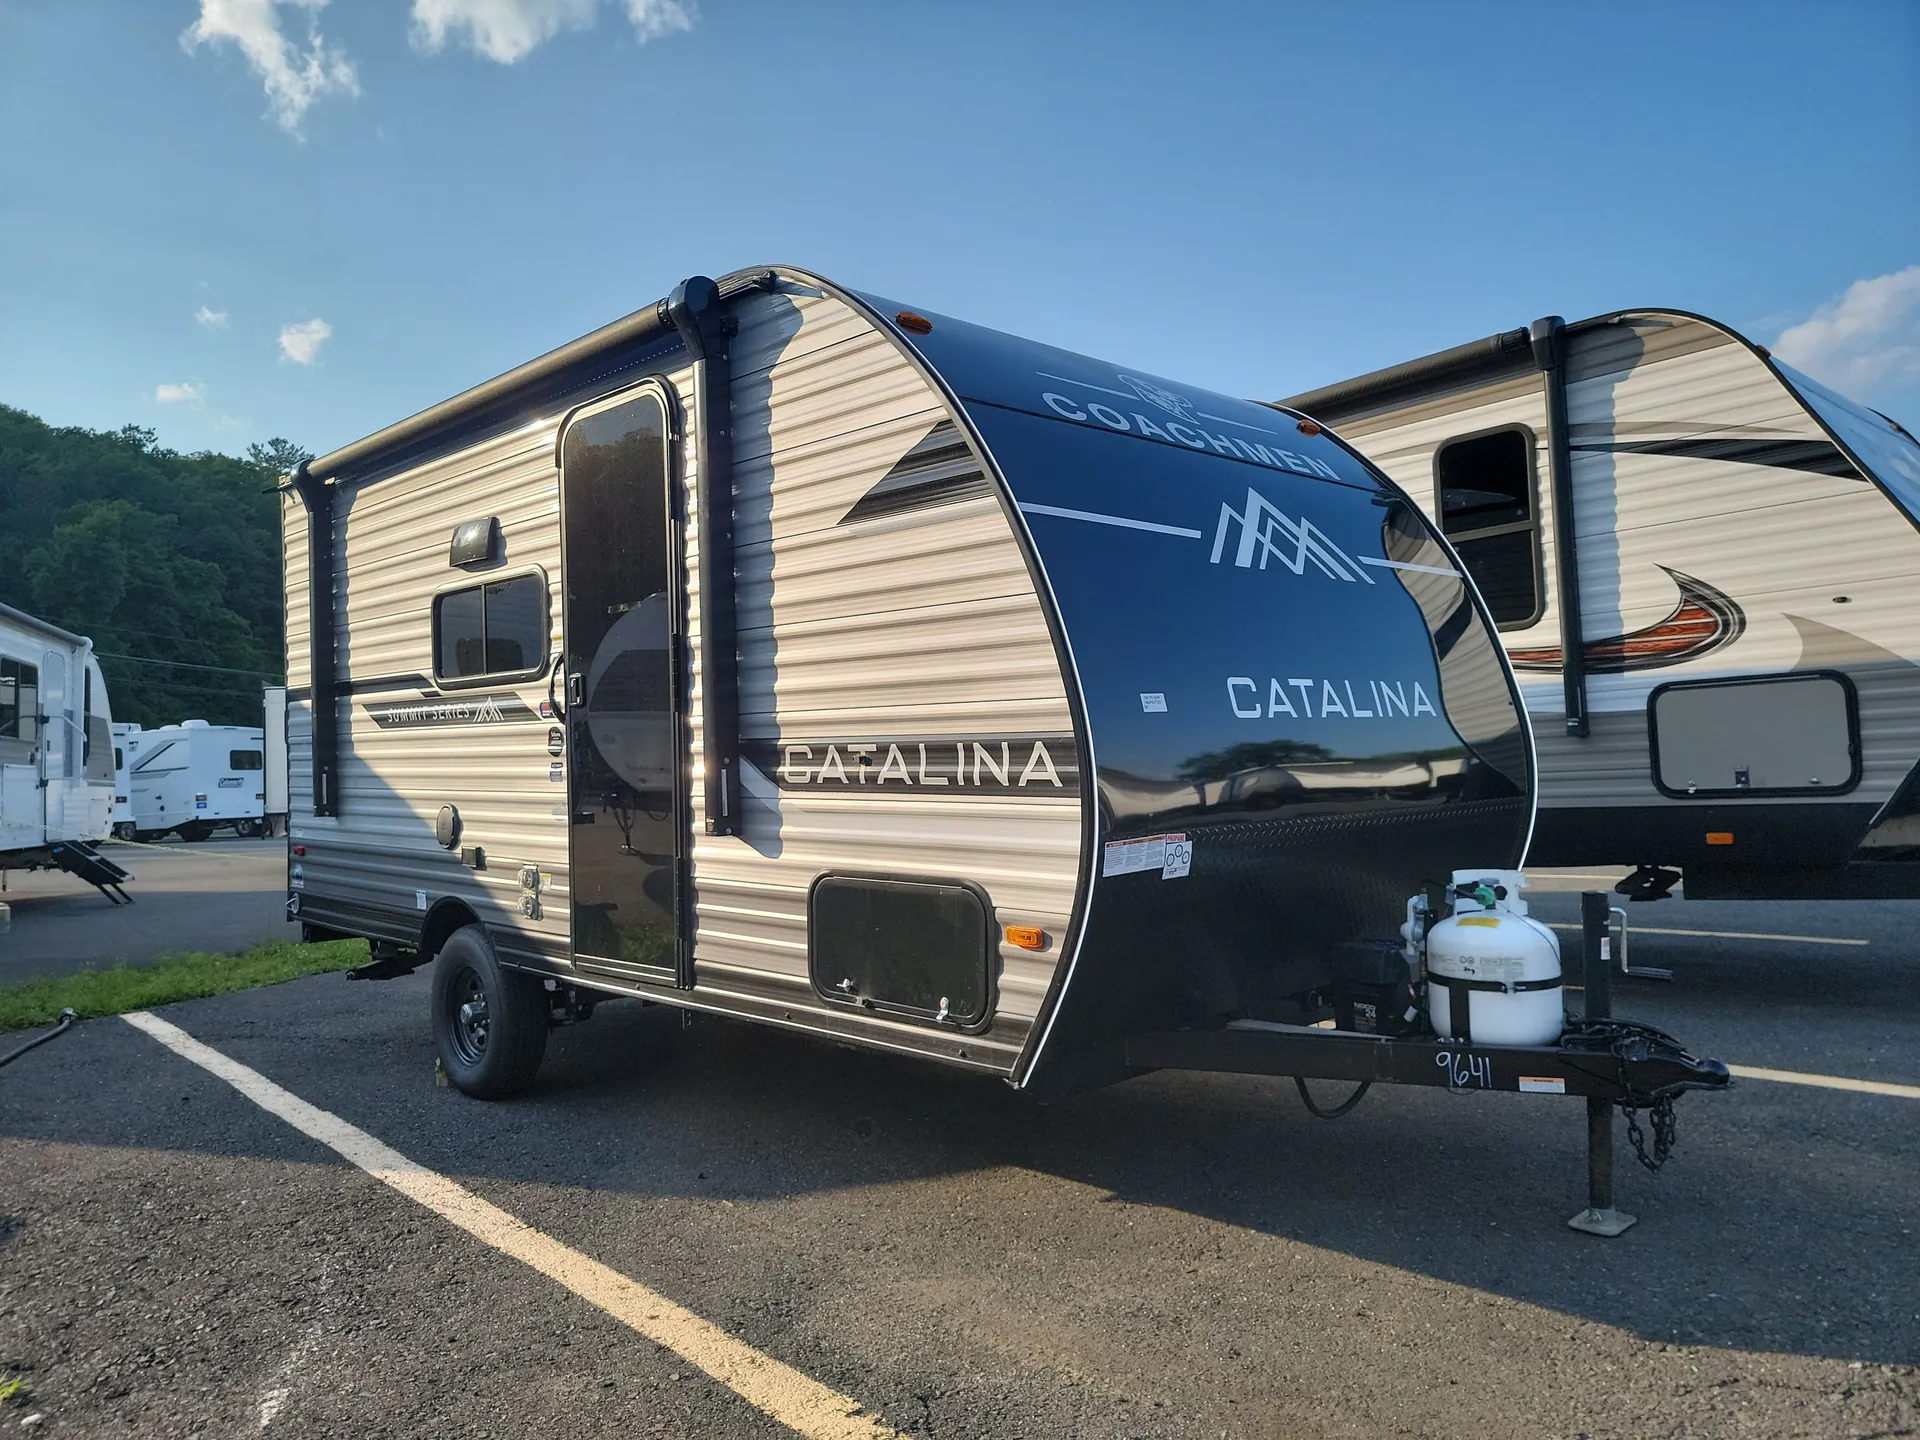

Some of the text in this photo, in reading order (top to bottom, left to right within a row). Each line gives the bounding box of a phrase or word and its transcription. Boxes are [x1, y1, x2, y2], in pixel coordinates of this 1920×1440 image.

[1042, 392, 1341, 481] COACHMEN
[388, 703, 470, 723] SUMMIT SERIES
[1227, 677, 1437, 719] CATALINA
[784, 740, 1063, 788] CATALINA
[1436, 1051, 1492, 1088] 9641
